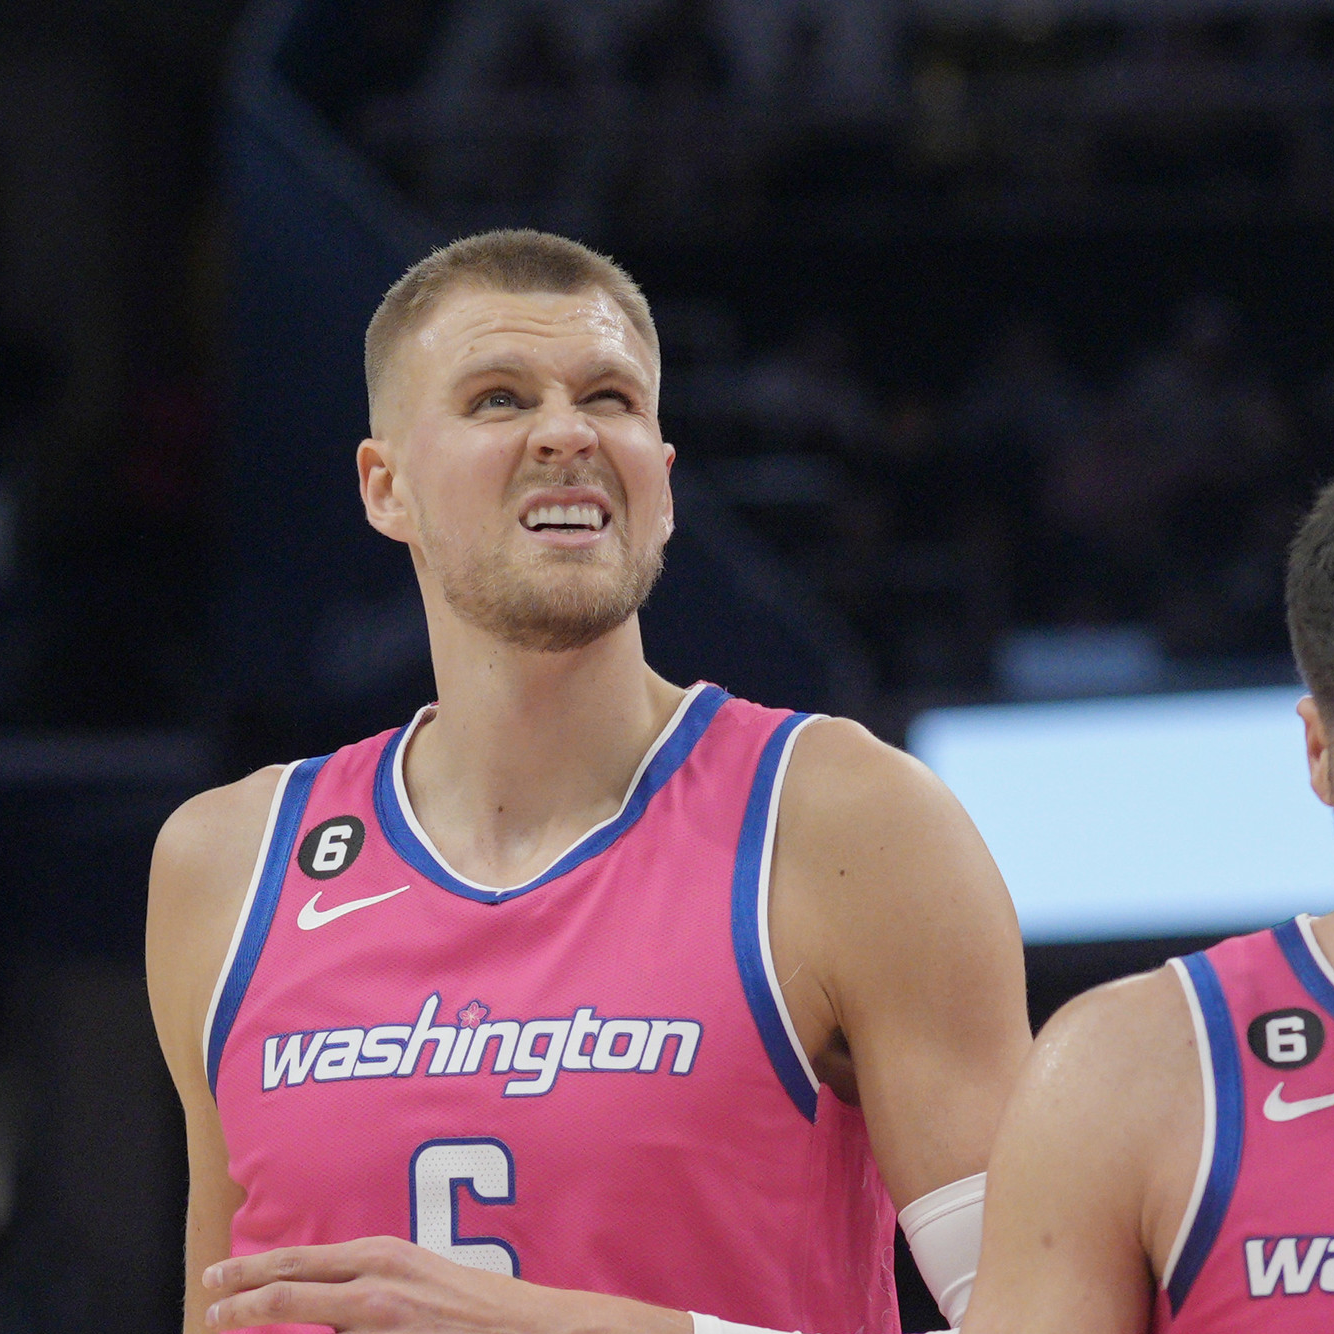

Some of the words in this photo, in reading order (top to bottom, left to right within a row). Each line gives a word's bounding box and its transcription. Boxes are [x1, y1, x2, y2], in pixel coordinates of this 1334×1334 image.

[312, 823, 353, 872] 6
[262, 991, 703, 1098] washington
[1266, 1015, 1307, 1063] 6
